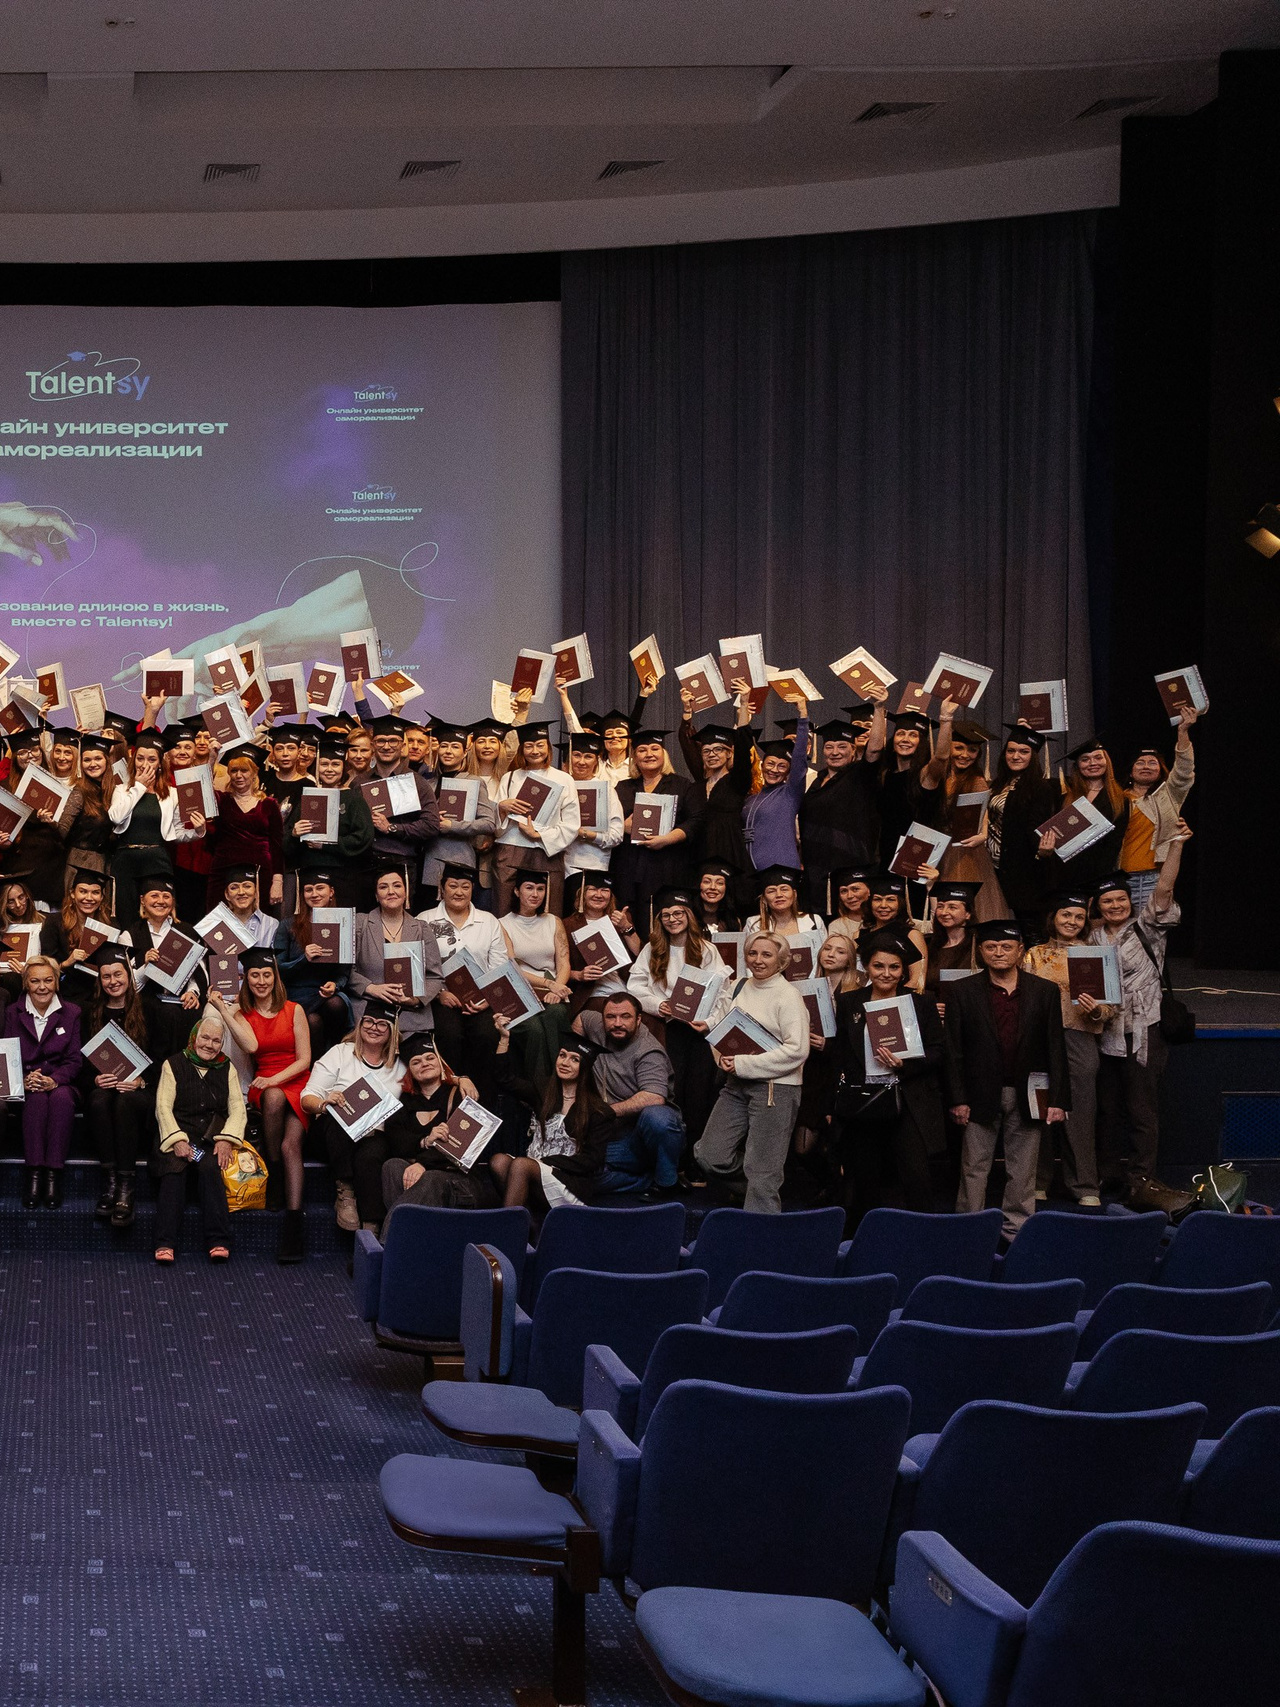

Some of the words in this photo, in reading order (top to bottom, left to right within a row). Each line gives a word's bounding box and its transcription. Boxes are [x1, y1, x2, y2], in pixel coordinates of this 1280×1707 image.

[26, 371, 150, 401] Talentsy
[354, 391, 398, 401] Talentsy
[54, 422, 228, 438] университет
[352, 491, 397, 501] Talentsy
[78, 602, 150, 613] длиною
[153, 603, 164, 612] в
[167, 602, 230, 613] жизнь,
[11, 617, 77, 627] вместе
[80, 617, 91, 627] с
[96, 616, 173, 629] Talentsy!
